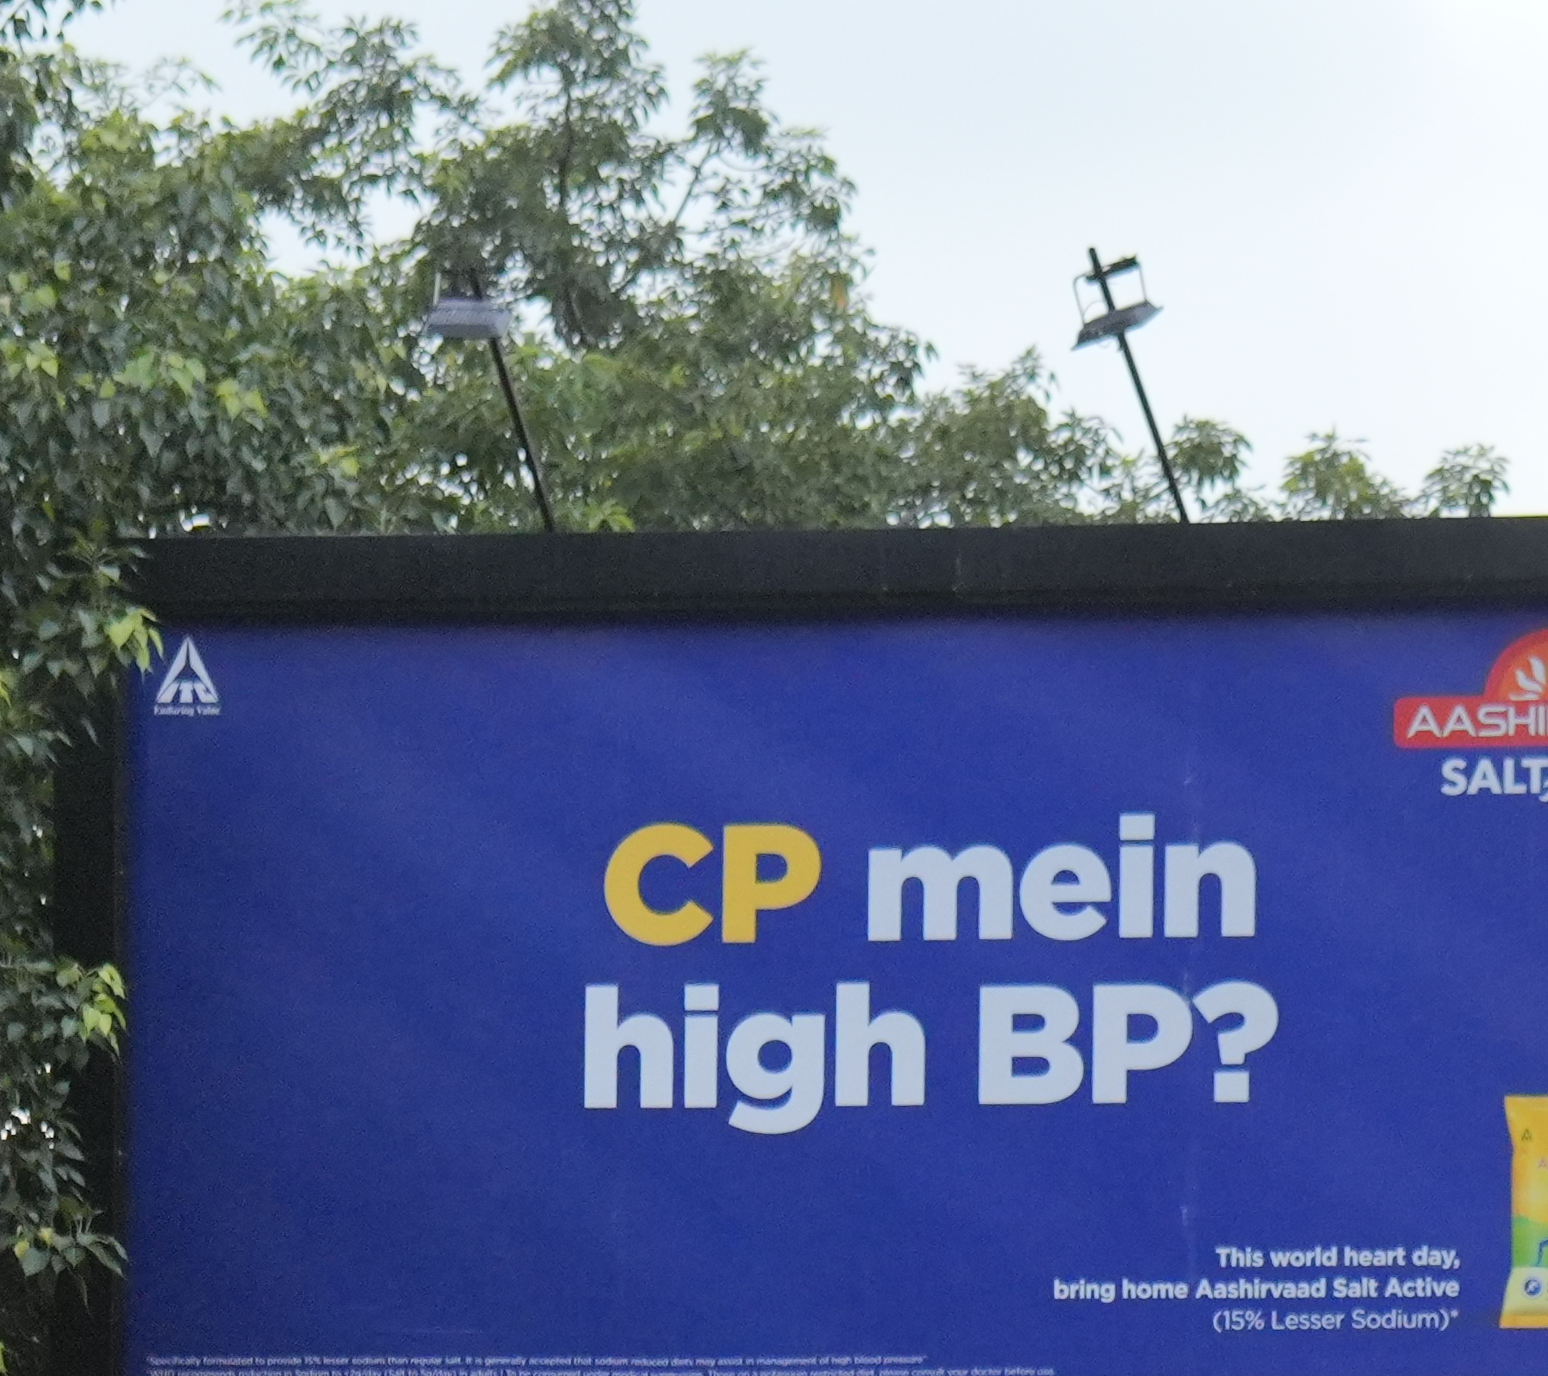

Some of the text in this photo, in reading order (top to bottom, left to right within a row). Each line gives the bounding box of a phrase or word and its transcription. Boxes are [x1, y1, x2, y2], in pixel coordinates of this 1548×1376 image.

[603, 813, 1256, 946] CP mein
[584, 981, 1279, 1134] high BP?
[1216, 1246, 1461, 1270] This world heart day,
[1053, 1276, 1459, 1303] bring home Aashirvaad Salt Active
[1212, 1310, 1264, 1332] (15%
[1272, 1311, 1343, 1330] Lesser
